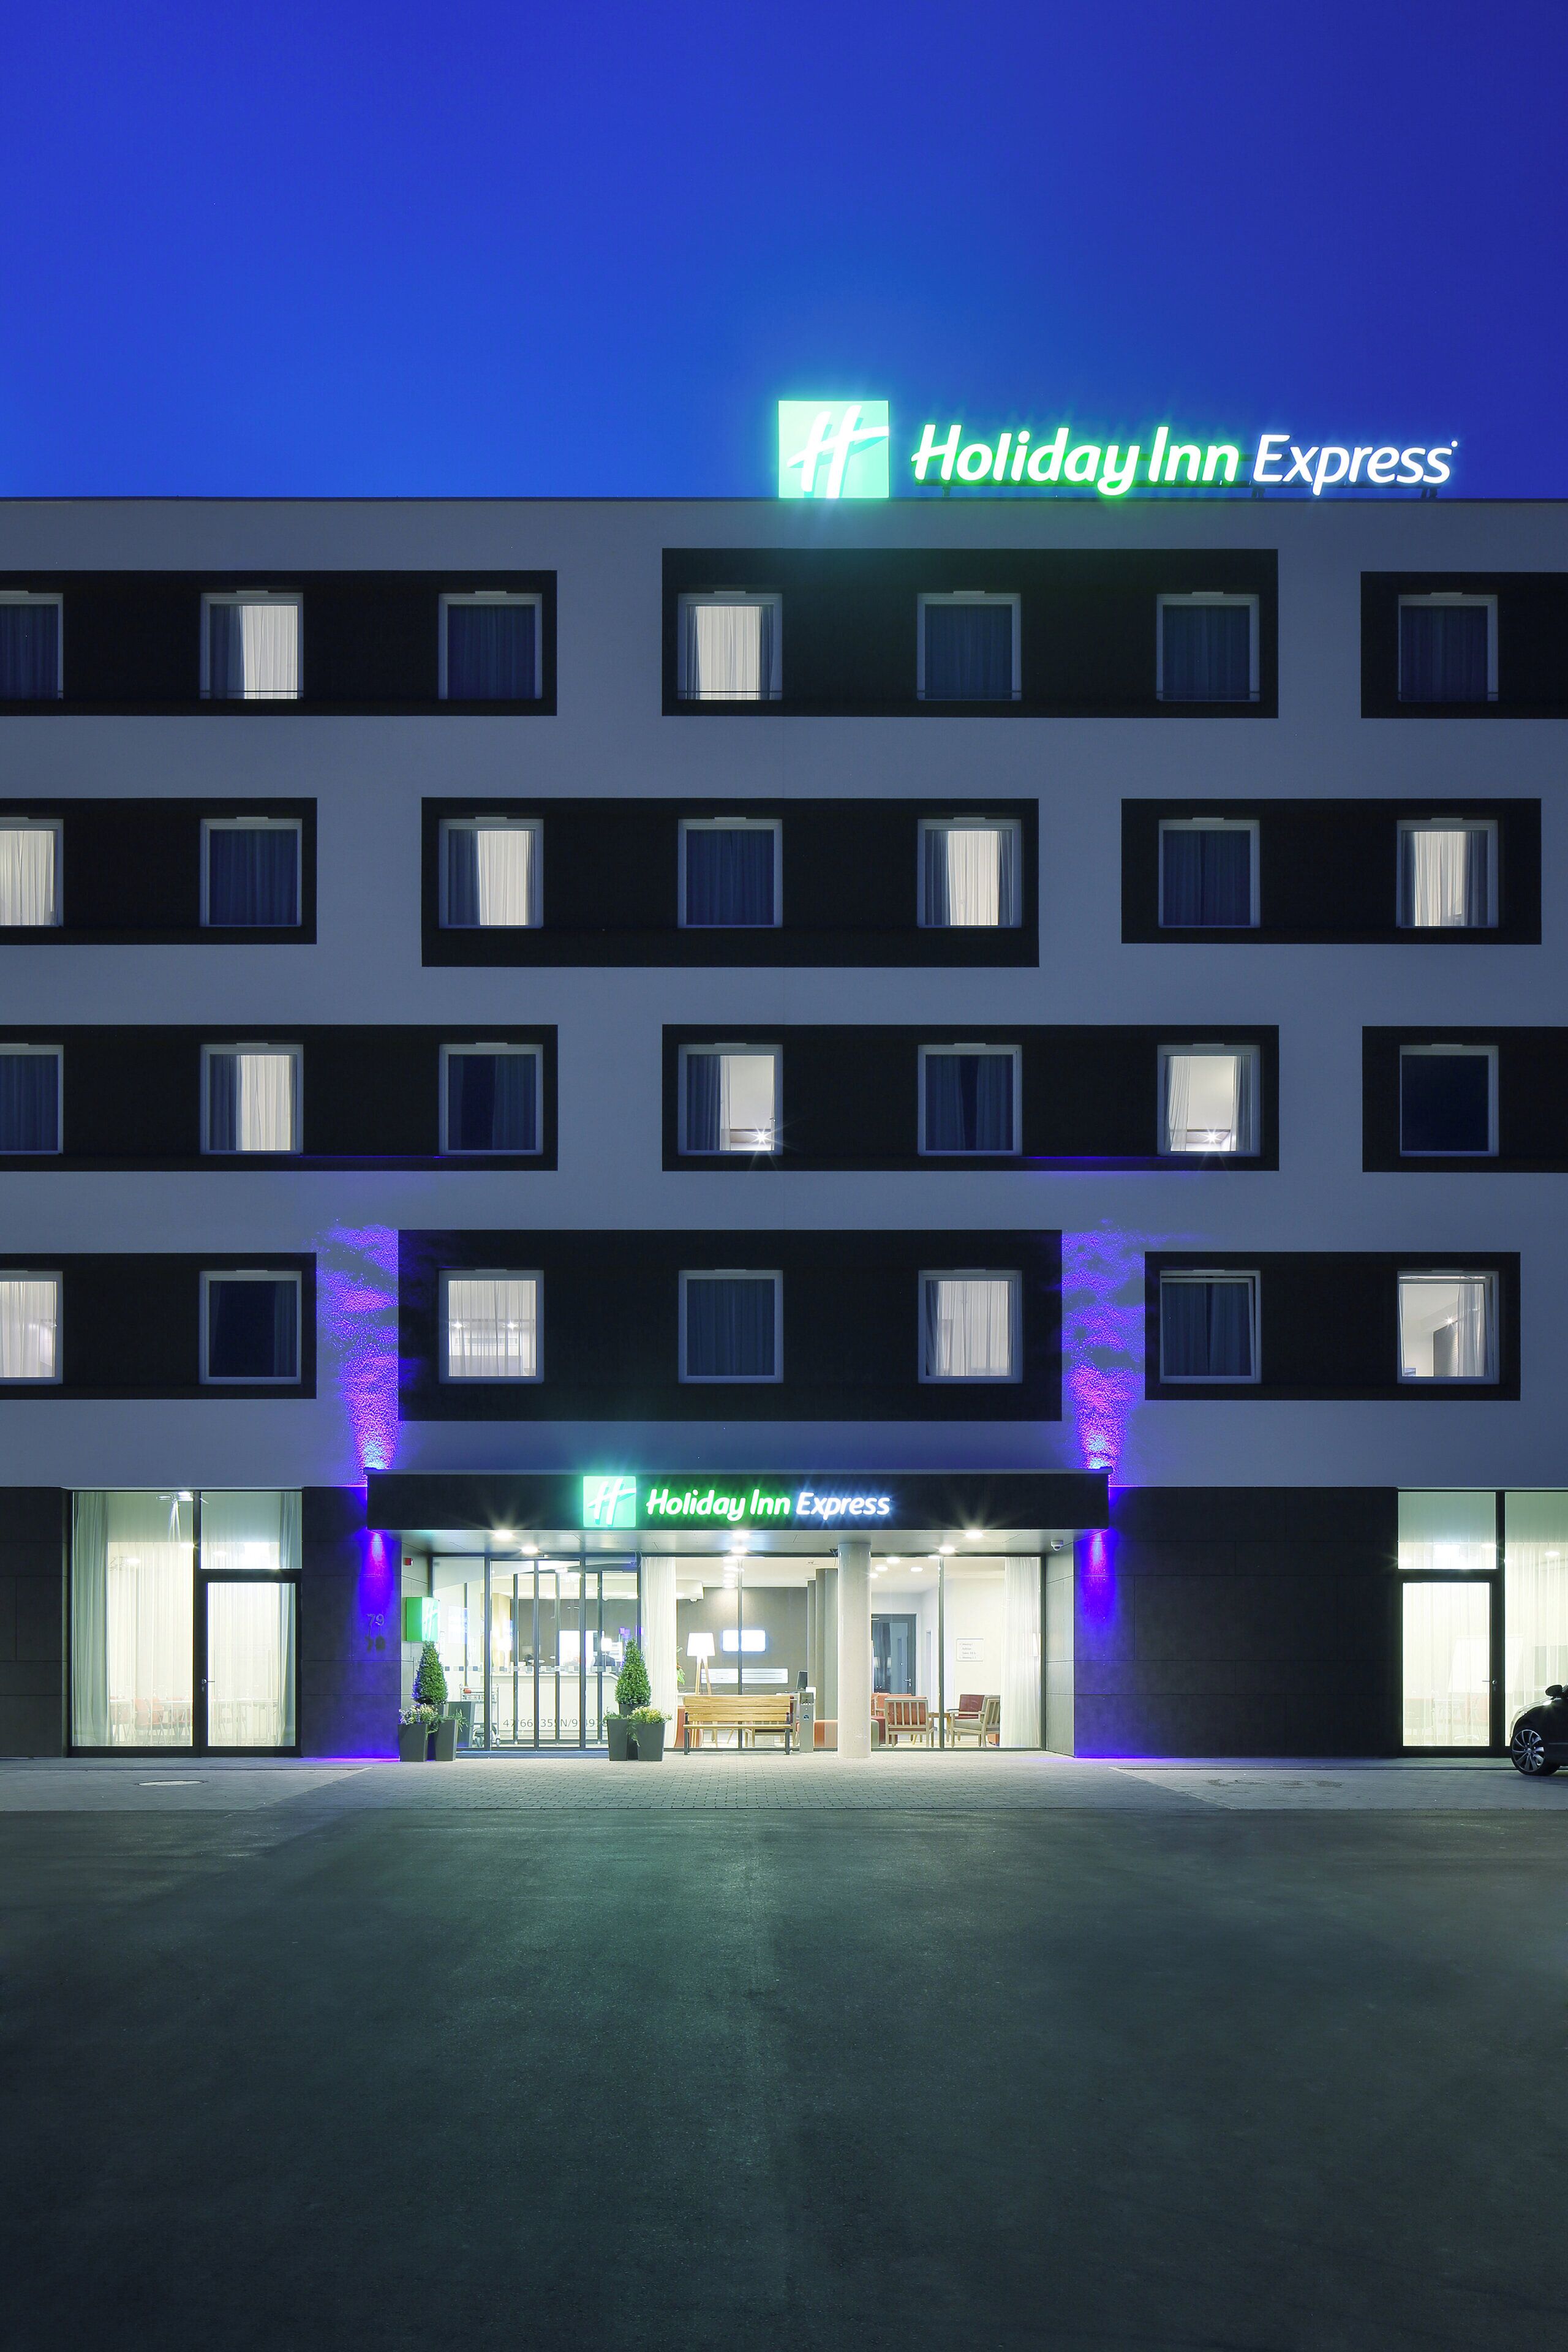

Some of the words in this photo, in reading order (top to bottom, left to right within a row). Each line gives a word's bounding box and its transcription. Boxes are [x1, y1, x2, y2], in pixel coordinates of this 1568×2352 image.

[910, 424, 1140, 496] Holiday
[1148, 426, 1239, 482] Inn
[1253, 434, 1454, 496] Express
[646, 1488, 746, 1521] Holiday
[750, 1488, 791, 1515] Inn
[796, 1491, 891, 1520] Express
[366, 1613, 385, 1627] 79
